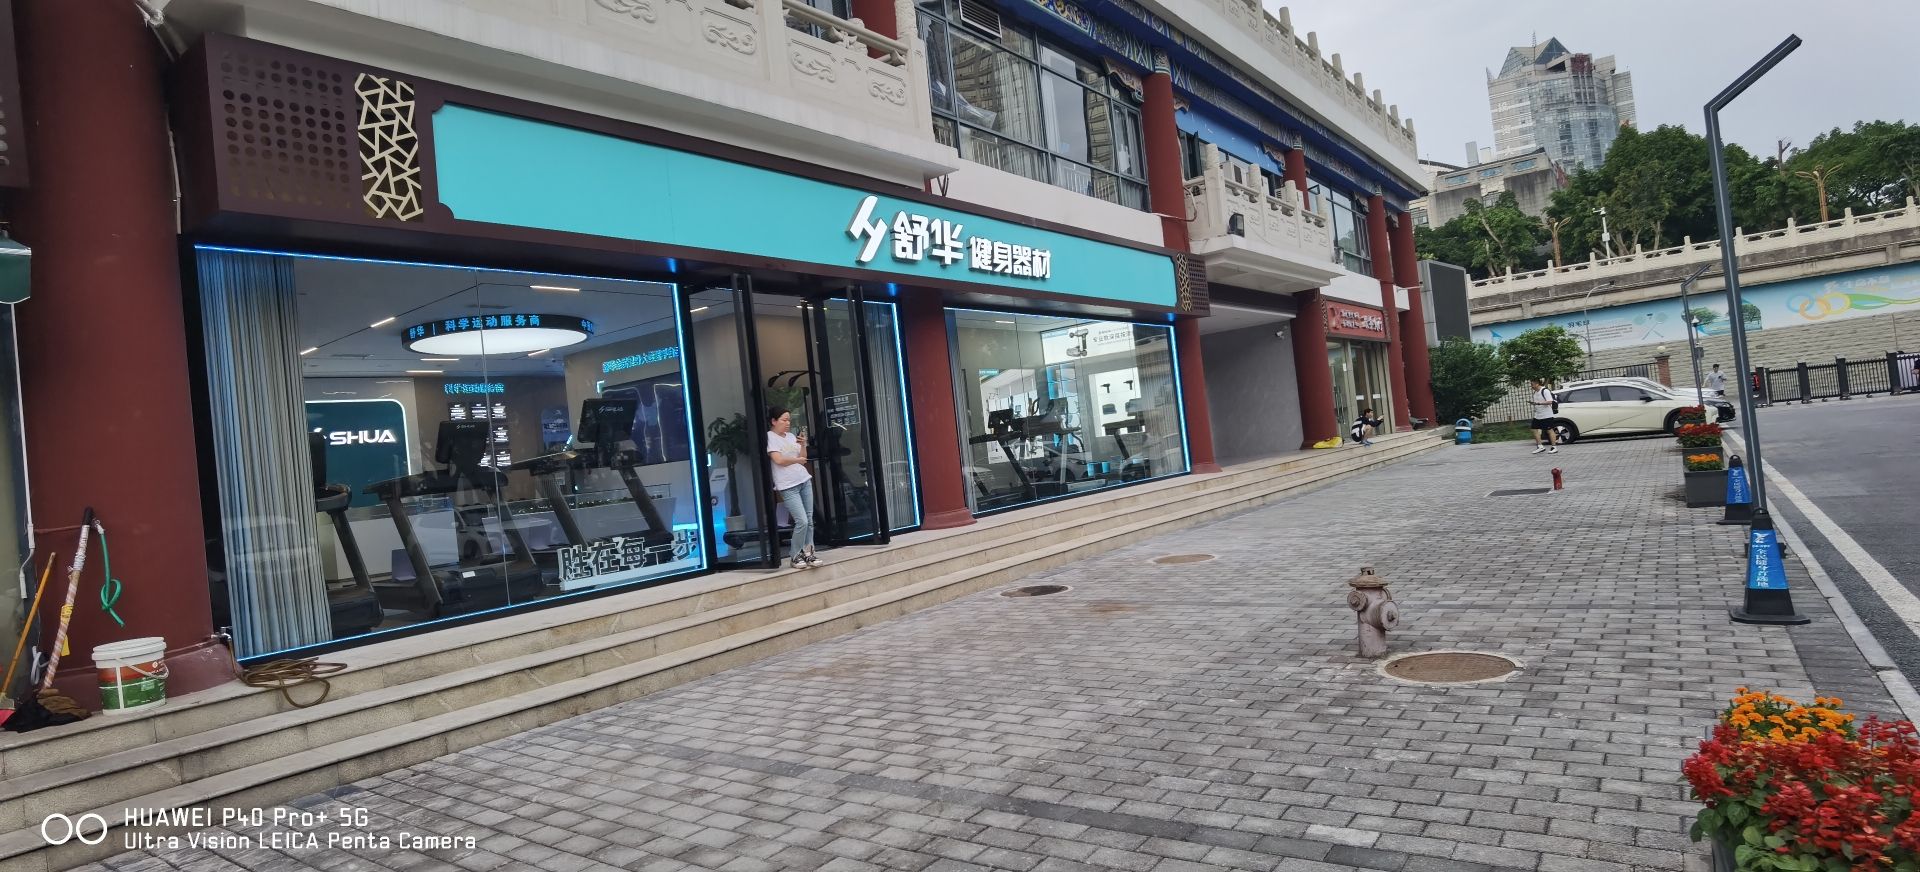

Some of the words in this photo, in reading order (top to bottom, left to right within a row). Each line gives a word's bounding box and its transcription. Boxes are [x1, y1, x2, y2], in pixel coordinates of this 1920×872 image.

[891, 210, 964, 266] 舒华
[969, 235, 1051, 280] 健身器材
[444, 314, 540, 332] 科学运动服务商
[329, 429, 397, 446] SHUA
[557, 528, 698, 582] 胜在每一步
